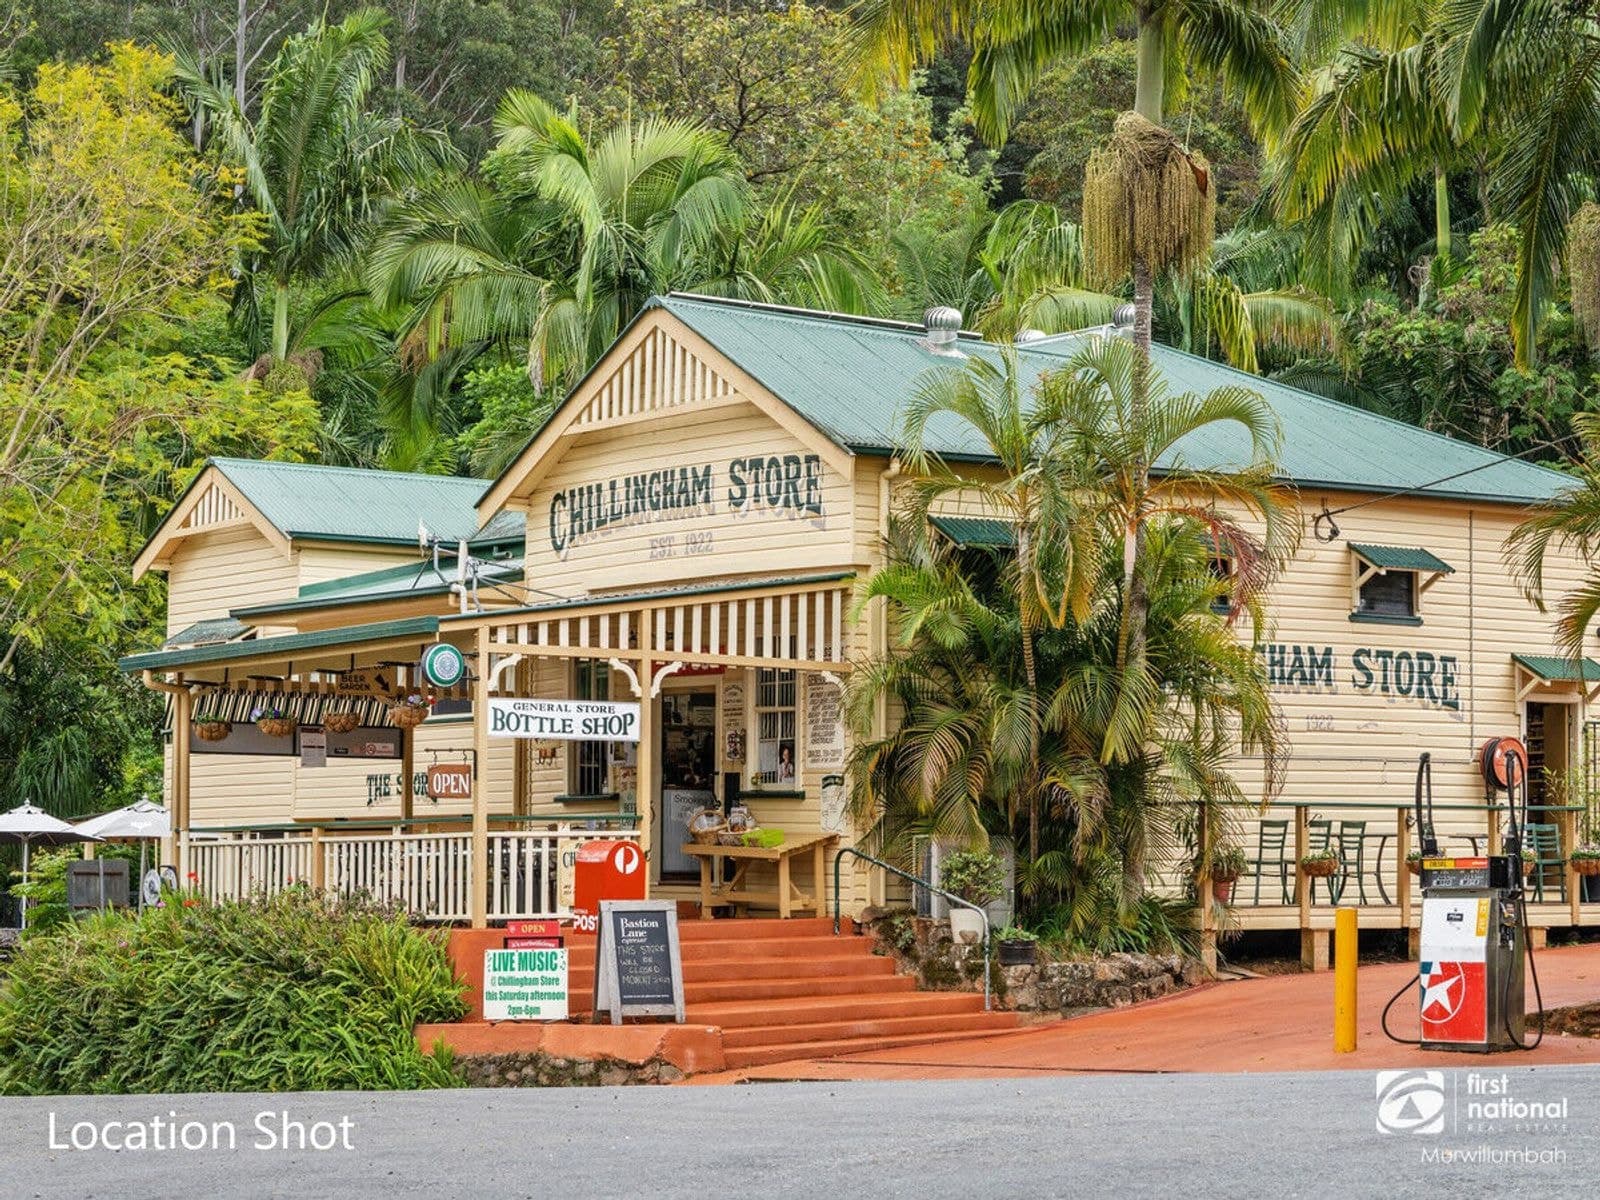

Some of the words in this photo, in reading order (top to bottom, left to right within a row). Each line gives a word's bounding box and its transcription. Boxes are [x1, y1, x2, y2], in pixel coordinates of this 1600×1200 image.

[549, 464, 712, 551] CHILLINGHAM
[728, 455, 822, 514] STORE
[1352, 648, 1460, 711] STORE
[513, 702, 571, 713] GENERAL
[576, 704, 616, 714] STORE
[491, 707, 574, 734] BOTTLE
[582, 712, 635, 735] SHOP
[432, 773, 470, 794] OPEN
[367, 774, 391, 806] THE
[521, 923, 546, 933] OPEN
[620, 917, 659, 928] Bastion
[621, 927, 647, 938] Lane
[492, 951, 515, 972] LIVE
[517, 951, 558, 972] MUSIC
[498, 976, 539, 987] Chillingham
[540, 976, 560, 986] Store
[485, 991, 497, 1001] this
[499, 991, 529, 1001] Saturday
[530, 991, 566, 1001] afternoon
[507, 1005, 541, 1015] 2pm-6pm
